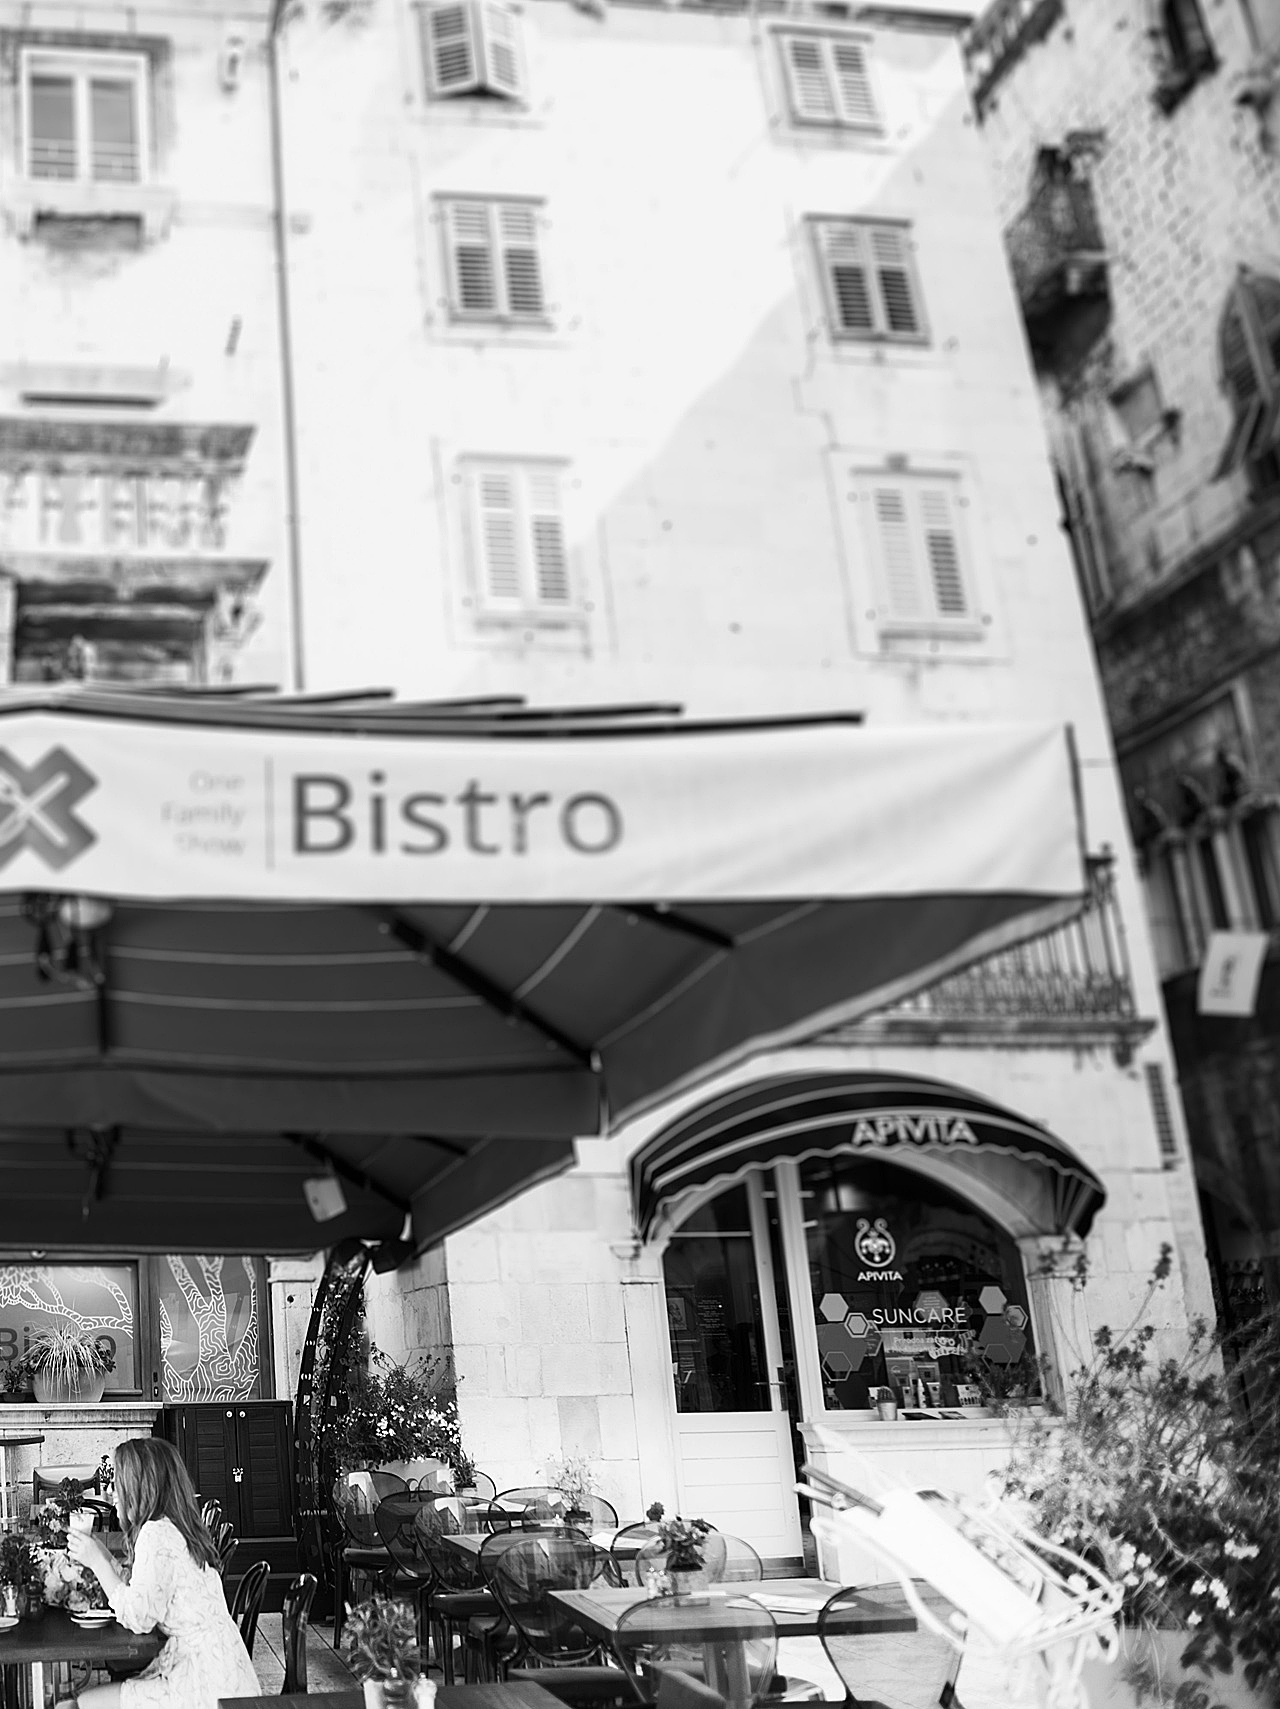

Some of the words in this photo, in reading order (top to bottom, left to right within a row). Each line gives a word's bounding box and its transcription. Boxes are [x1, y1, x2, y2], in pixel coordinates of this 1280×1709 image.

[292, 769, 623, 857] Bistro
[851, 1116, 979, 1144] APIVITA
[857, 1270, 903, 1281] APIVITA
[872, 1307, 967, 1324] SUNCARE
